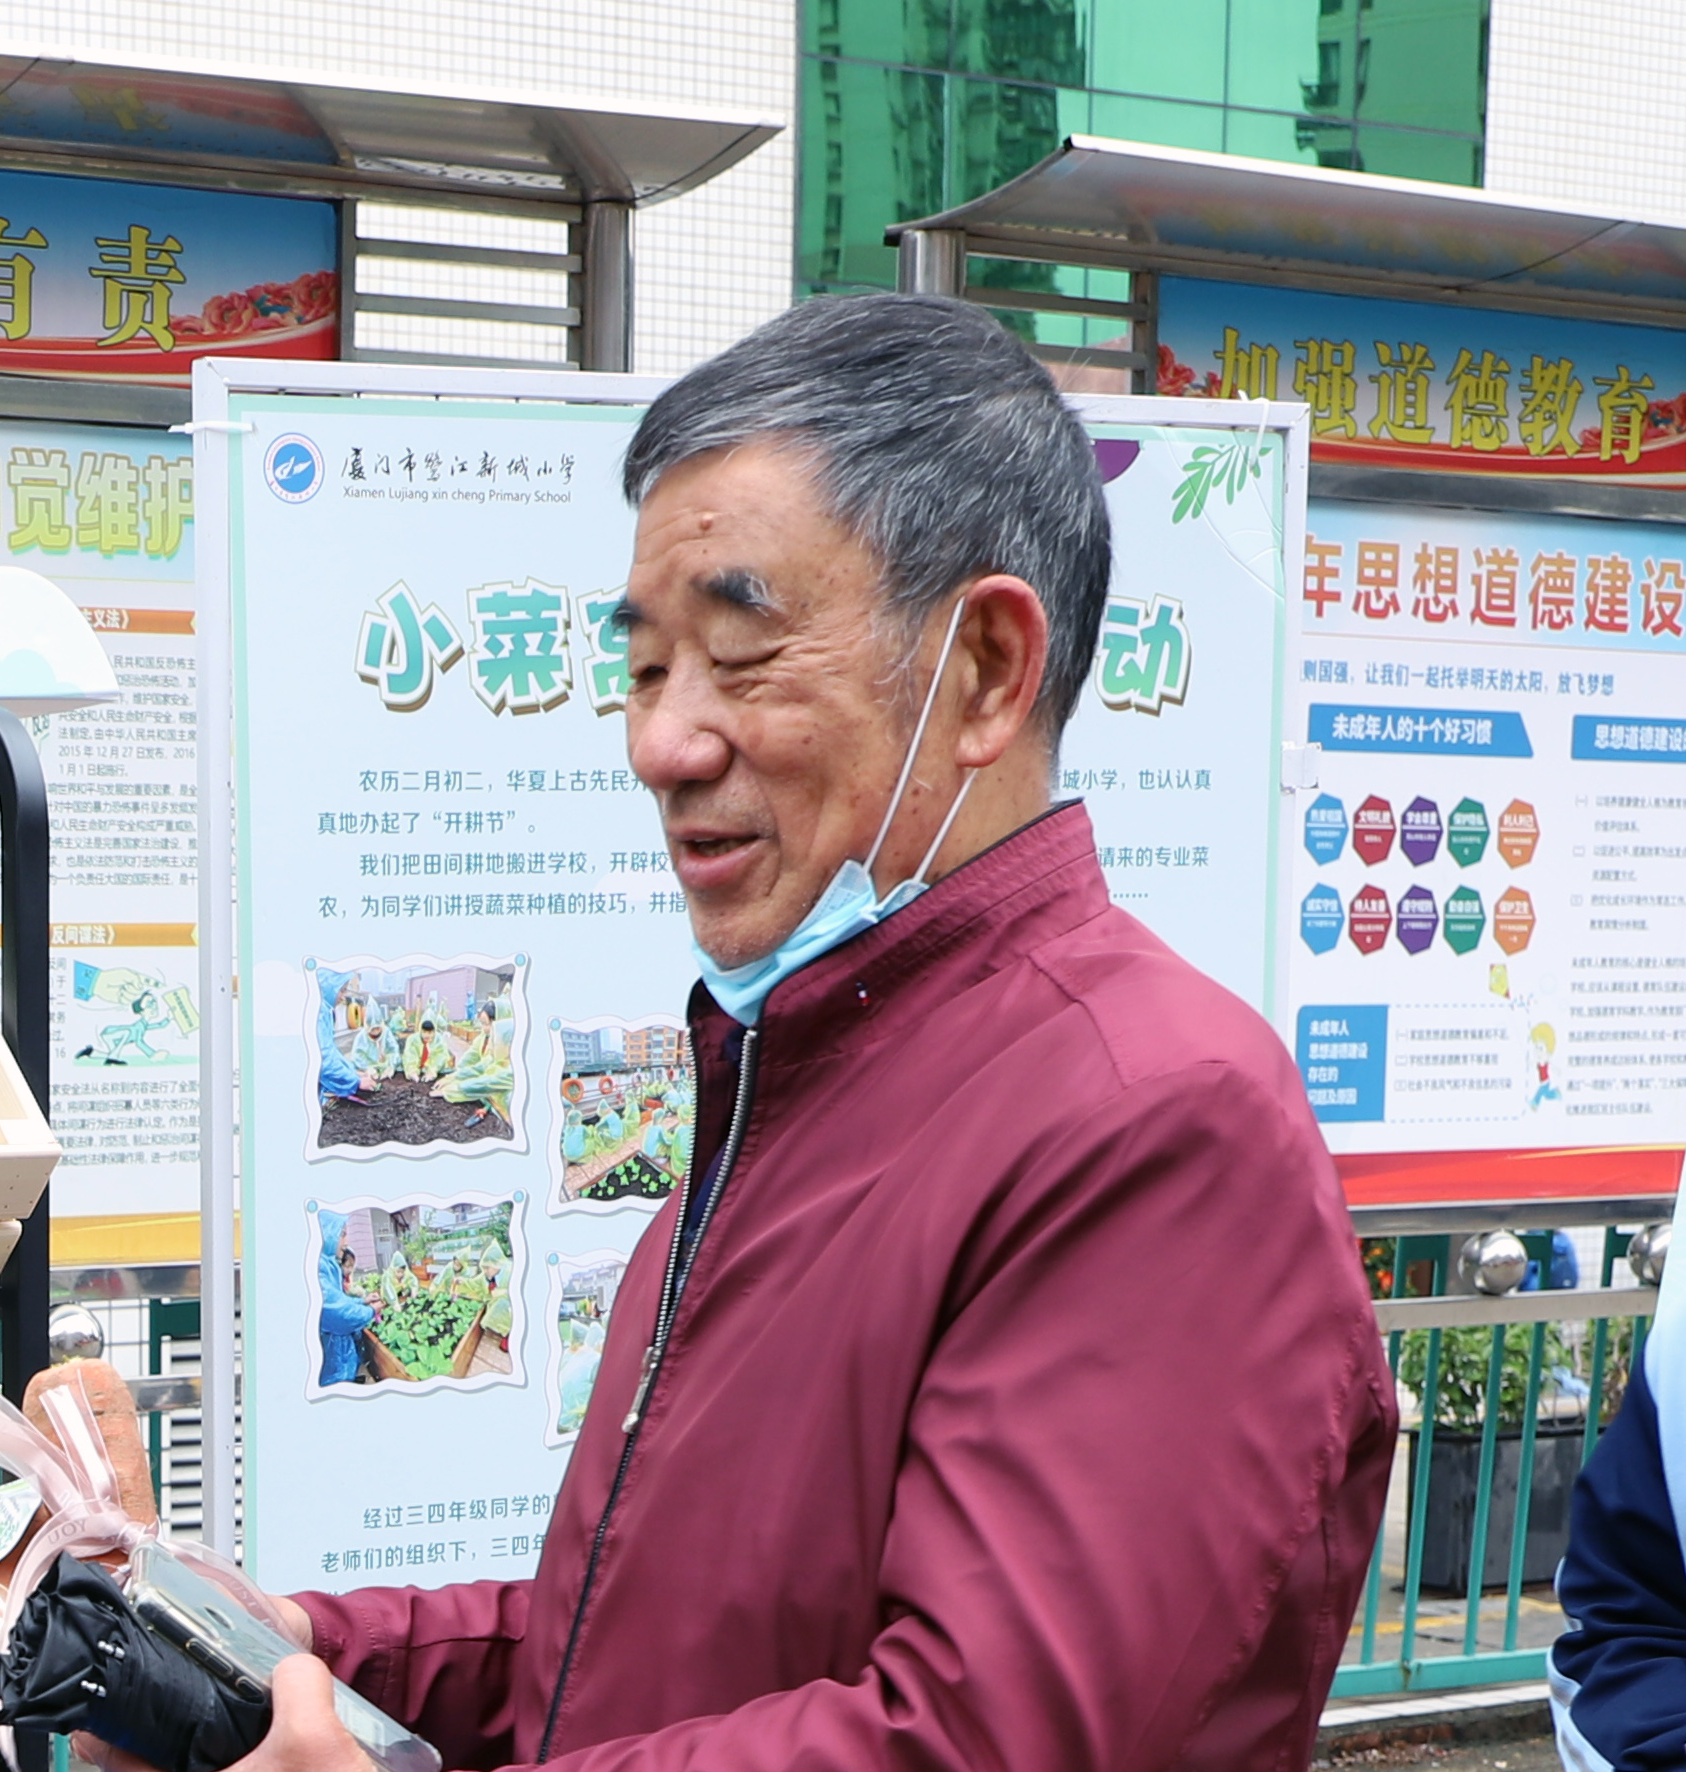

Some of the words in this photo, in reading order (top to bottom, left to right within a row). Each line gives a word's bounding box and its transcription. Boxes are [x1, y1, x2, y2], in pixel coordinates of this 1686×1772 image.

[1213, 325, 1657, 466] 加强道德教育
[342, 486, 386, 499] Xiamen
[388, 486, 429, 503] Lujiang
[431, 487, 449, 500] xin
[451, 488, 485, 505] cheng
[488, 489, 532, 505] Primary
[533, 490, 572, 503] School
[109, 654, 196, 671] 民共和国反恐怖主
[1100, 604, 1186, 704] 动
[1301, 659, 1615, 697] 则国强，让我们一起托举明天的太阳，放飞梦想
[1331, 713, 1493, 746] 未成年人的十个好习惯
[1058, 768, 1212, 791] 城小学，也认认真
[358, 850, 677, 878] 我们把田间耕地搬进学校，开辟校
[1099, 846, 1210, 868] 请来的专业菜
[362, 1494, 560, 1531] 经过三四年级同学的
